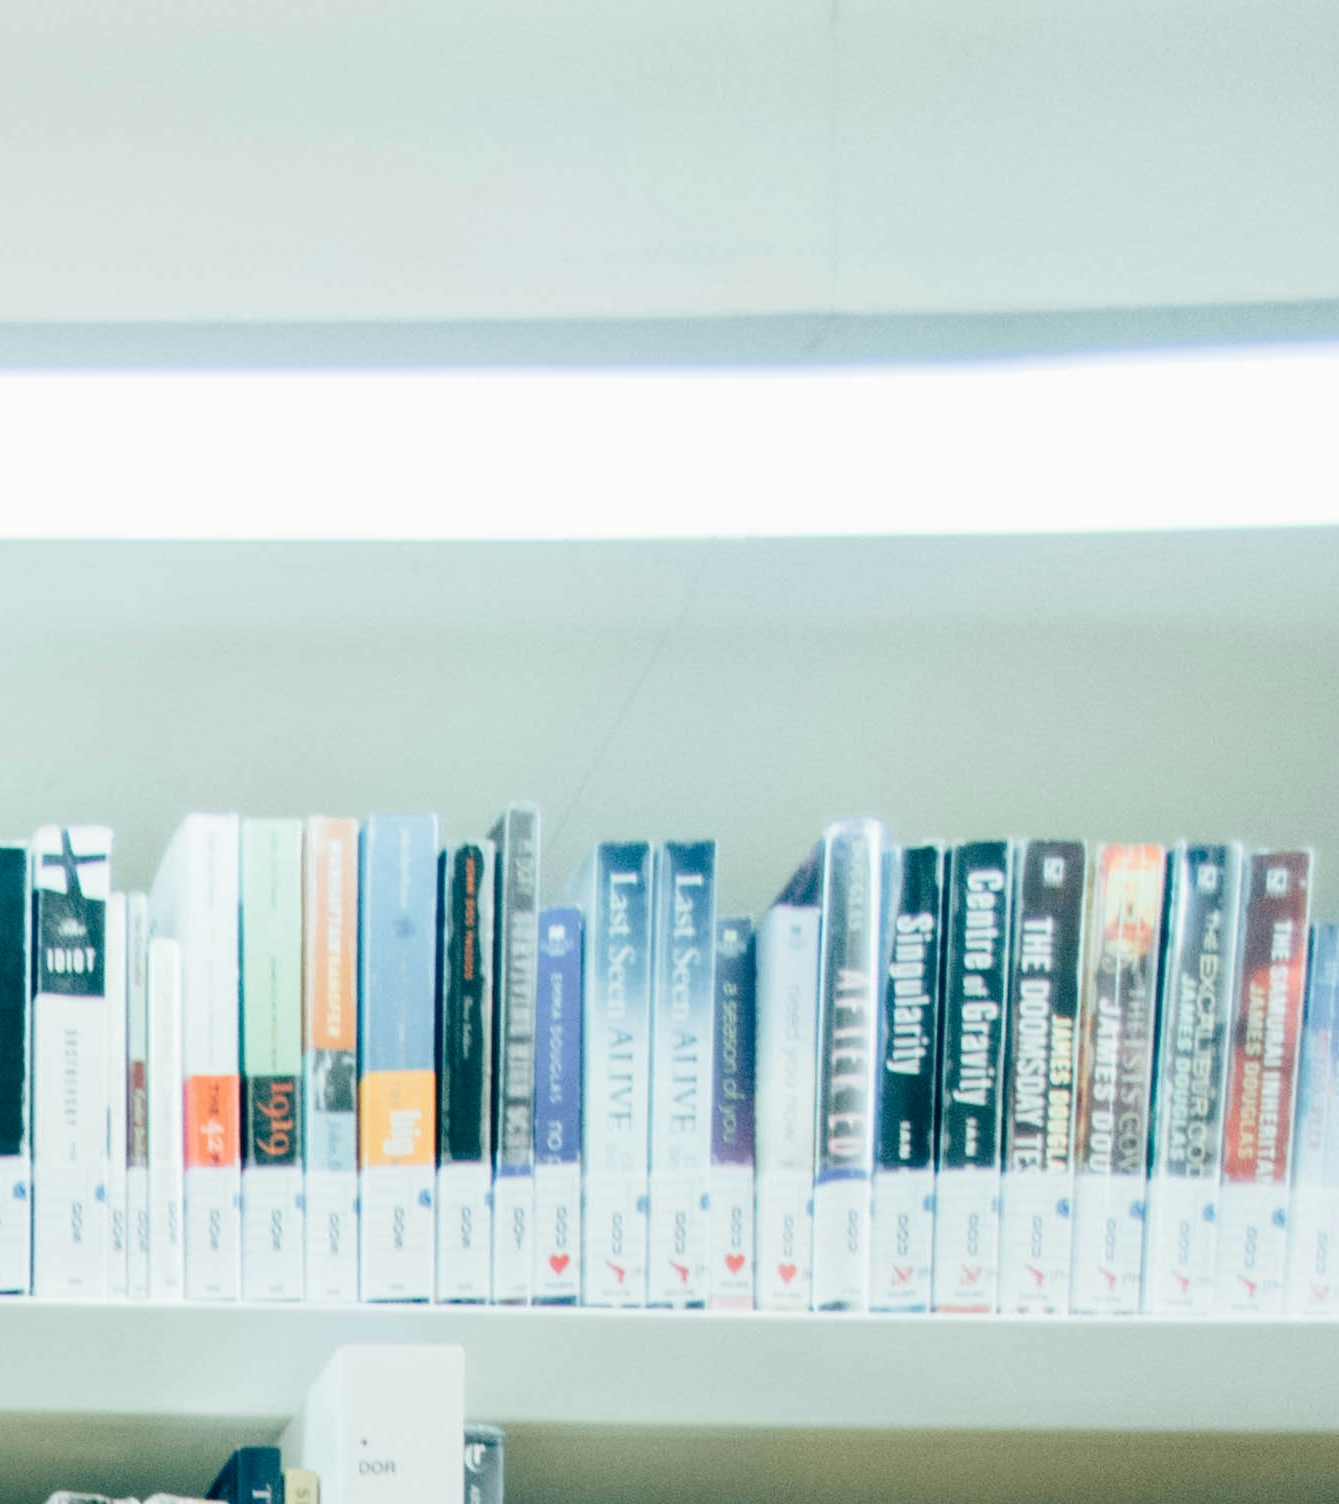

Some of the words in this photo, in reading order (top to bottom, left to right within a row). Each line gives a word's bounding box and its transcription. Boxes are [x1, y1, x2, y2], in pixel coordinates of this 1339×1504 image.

[45, 948, 96, 974] IDIOT
[968, 868, 1003, 971] Centre
[1021, 918, 1053, 973] THE
[887, 912, 933, 1075] Singularity
[956, 1000, 1001, 1107] Gravity
[1017, 980, 1050, 1126] DOOMSDAY
[357, 1458, 397, 1476] DOR
